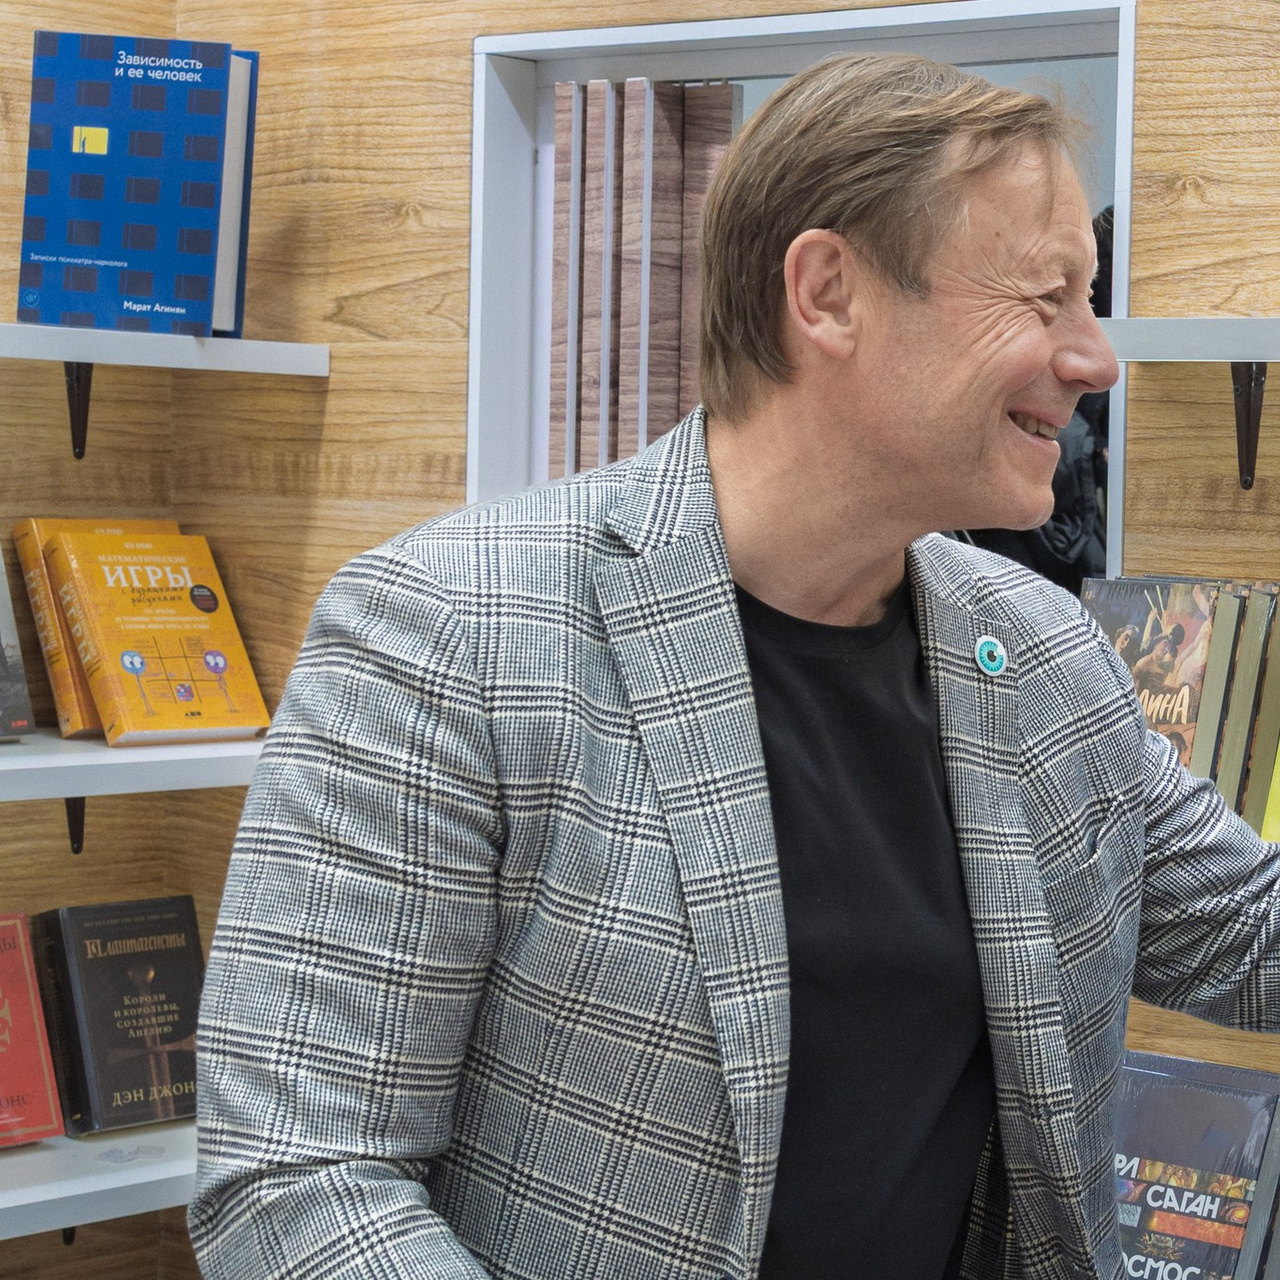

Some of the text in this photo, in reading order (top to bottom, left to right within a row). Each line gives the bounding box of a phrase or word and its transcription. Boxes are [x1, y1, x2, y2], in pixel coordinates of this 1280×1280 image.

[117, 51, 203, 70] Зависимость
[115, 66, 202, 83] и ее человек
[123, 299, 186, 315] Марат Агинян
[101, 565, 194, 589] ИГРЫ
[112, 1081, 197, 1108] ДЭН ДЖОН
[1146, 1184, 1221, 1219] САГАН
